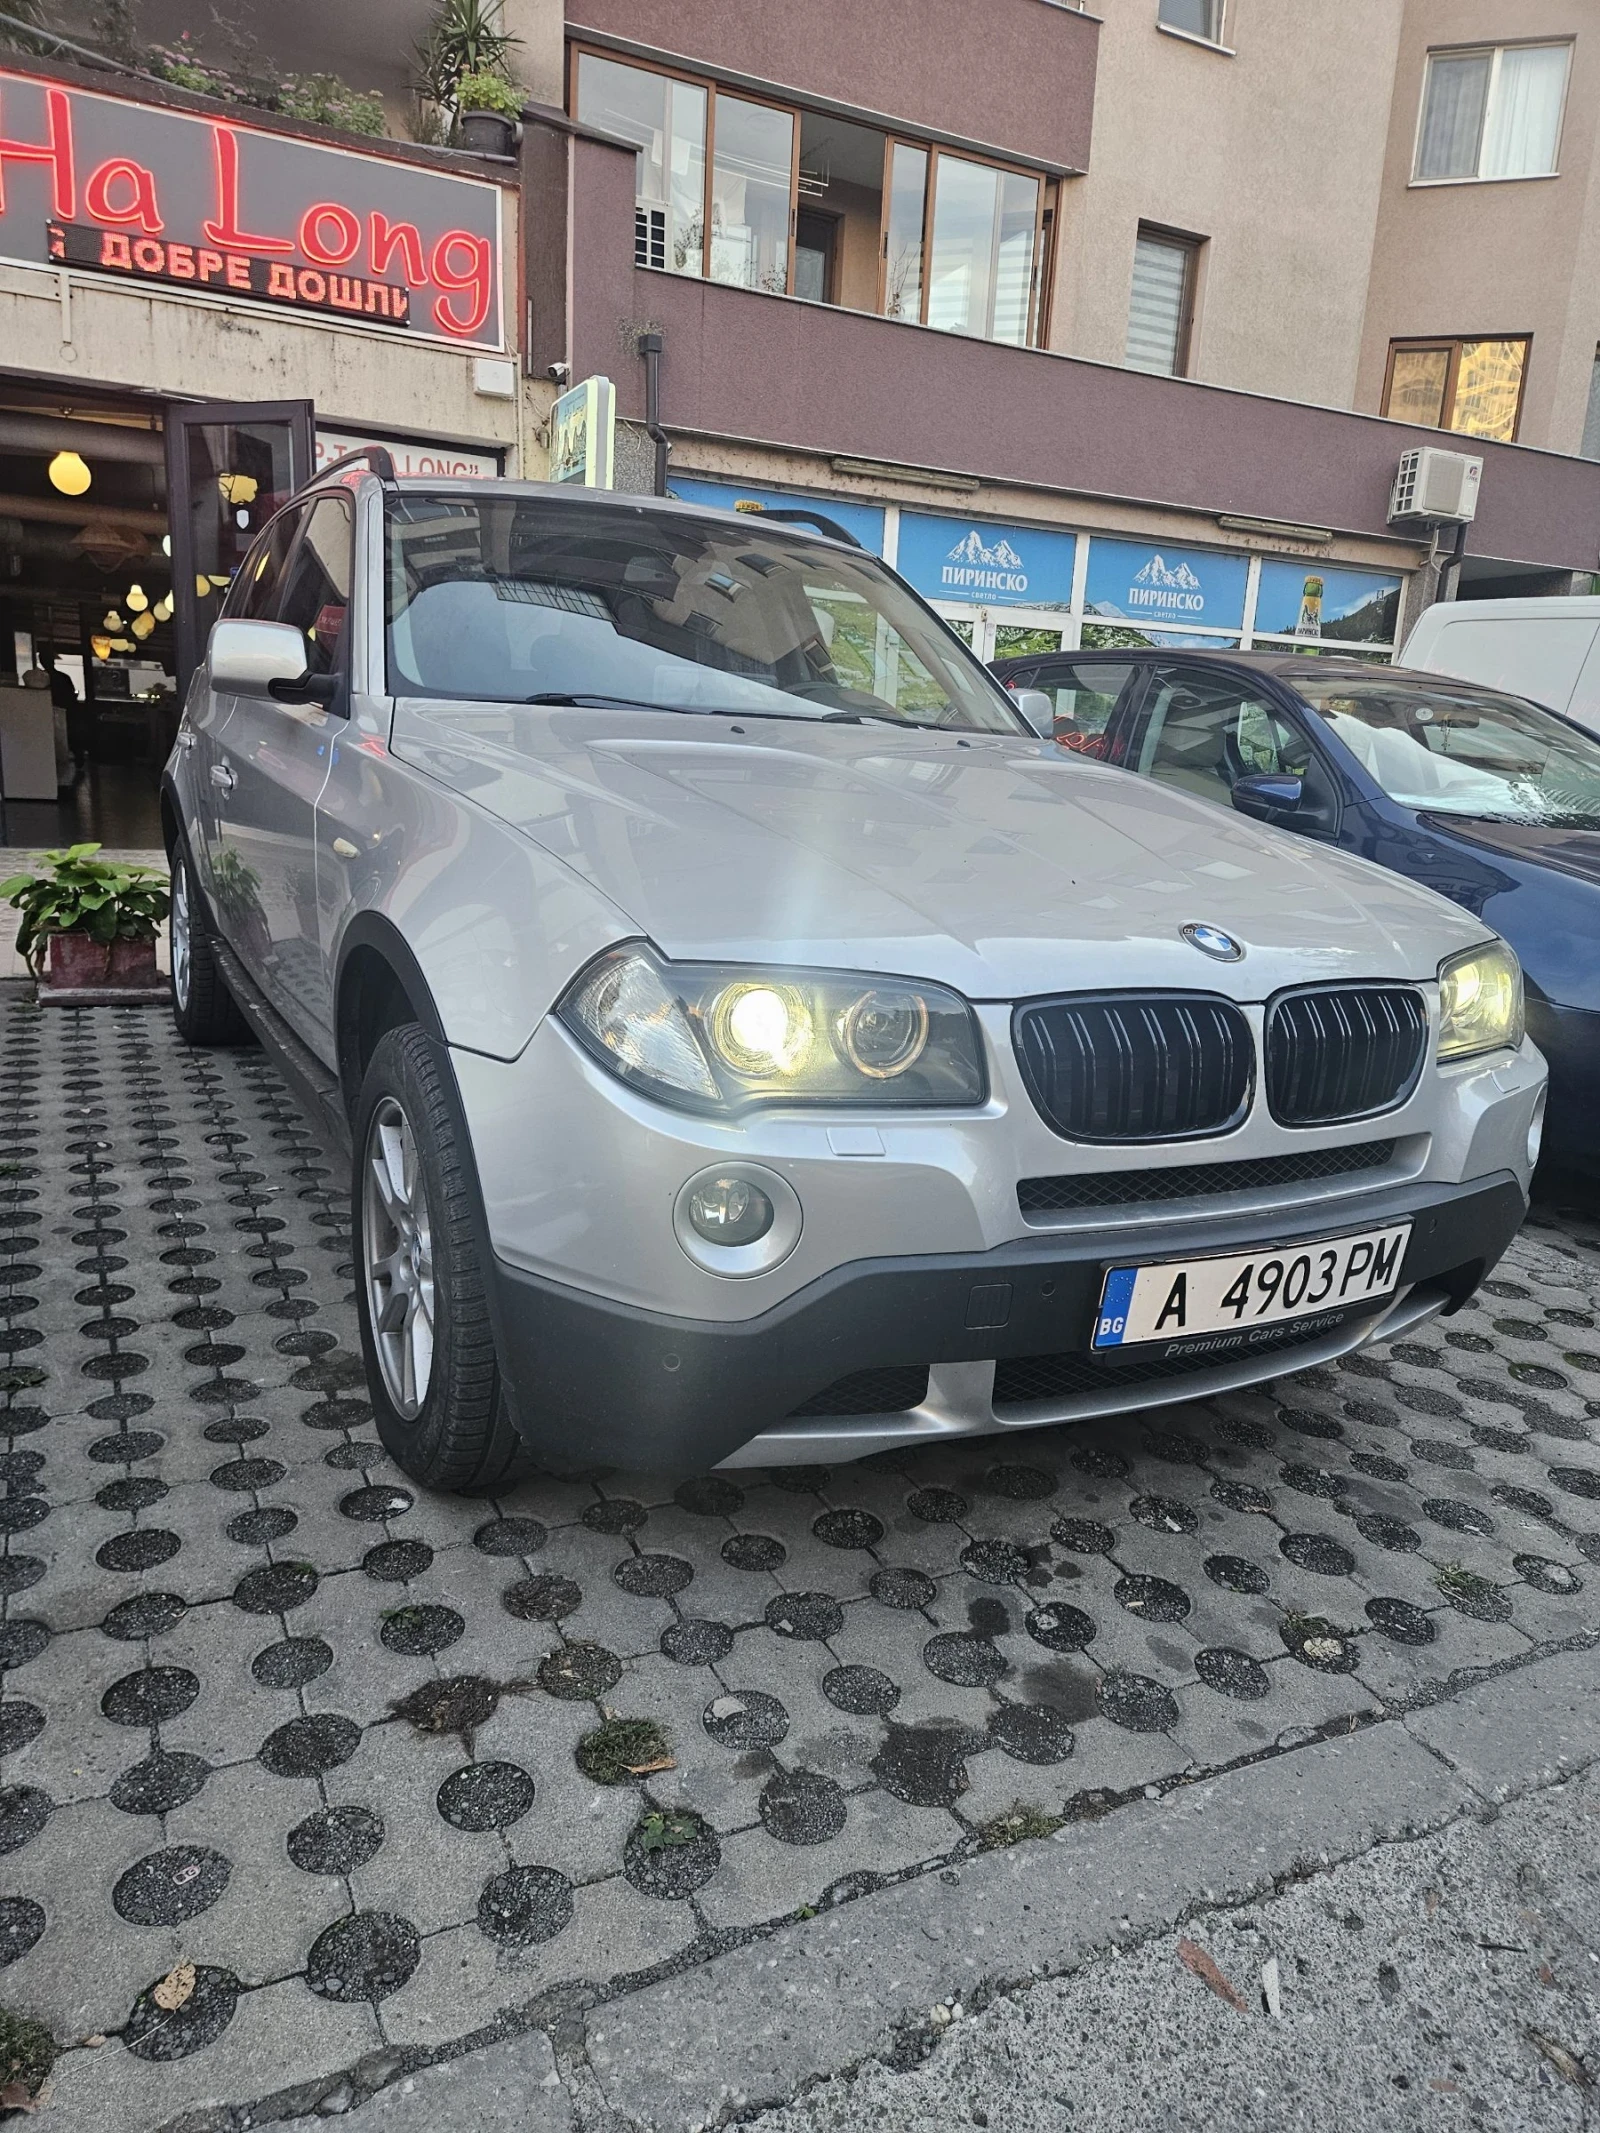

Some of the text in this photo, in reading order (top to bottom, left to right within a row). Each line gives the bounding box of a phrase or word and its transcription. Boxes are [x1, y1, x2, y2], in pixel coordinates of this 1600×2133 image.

[0, 88, 492, 334] Ha Long
[101, 231, 252, 290] ДОБРЕ
[941, 565, 1028, 592] ПИРИНСКО
[971, 591, 997, 601] светло
[1128, 587, 1205, 611] ПИРИНСКО
[1154, 1272, 1187, 1330] A
[1099, 1317, 1124, 1336] BG
[1164, 1311, 1344, 1357] Premium Cars Service
